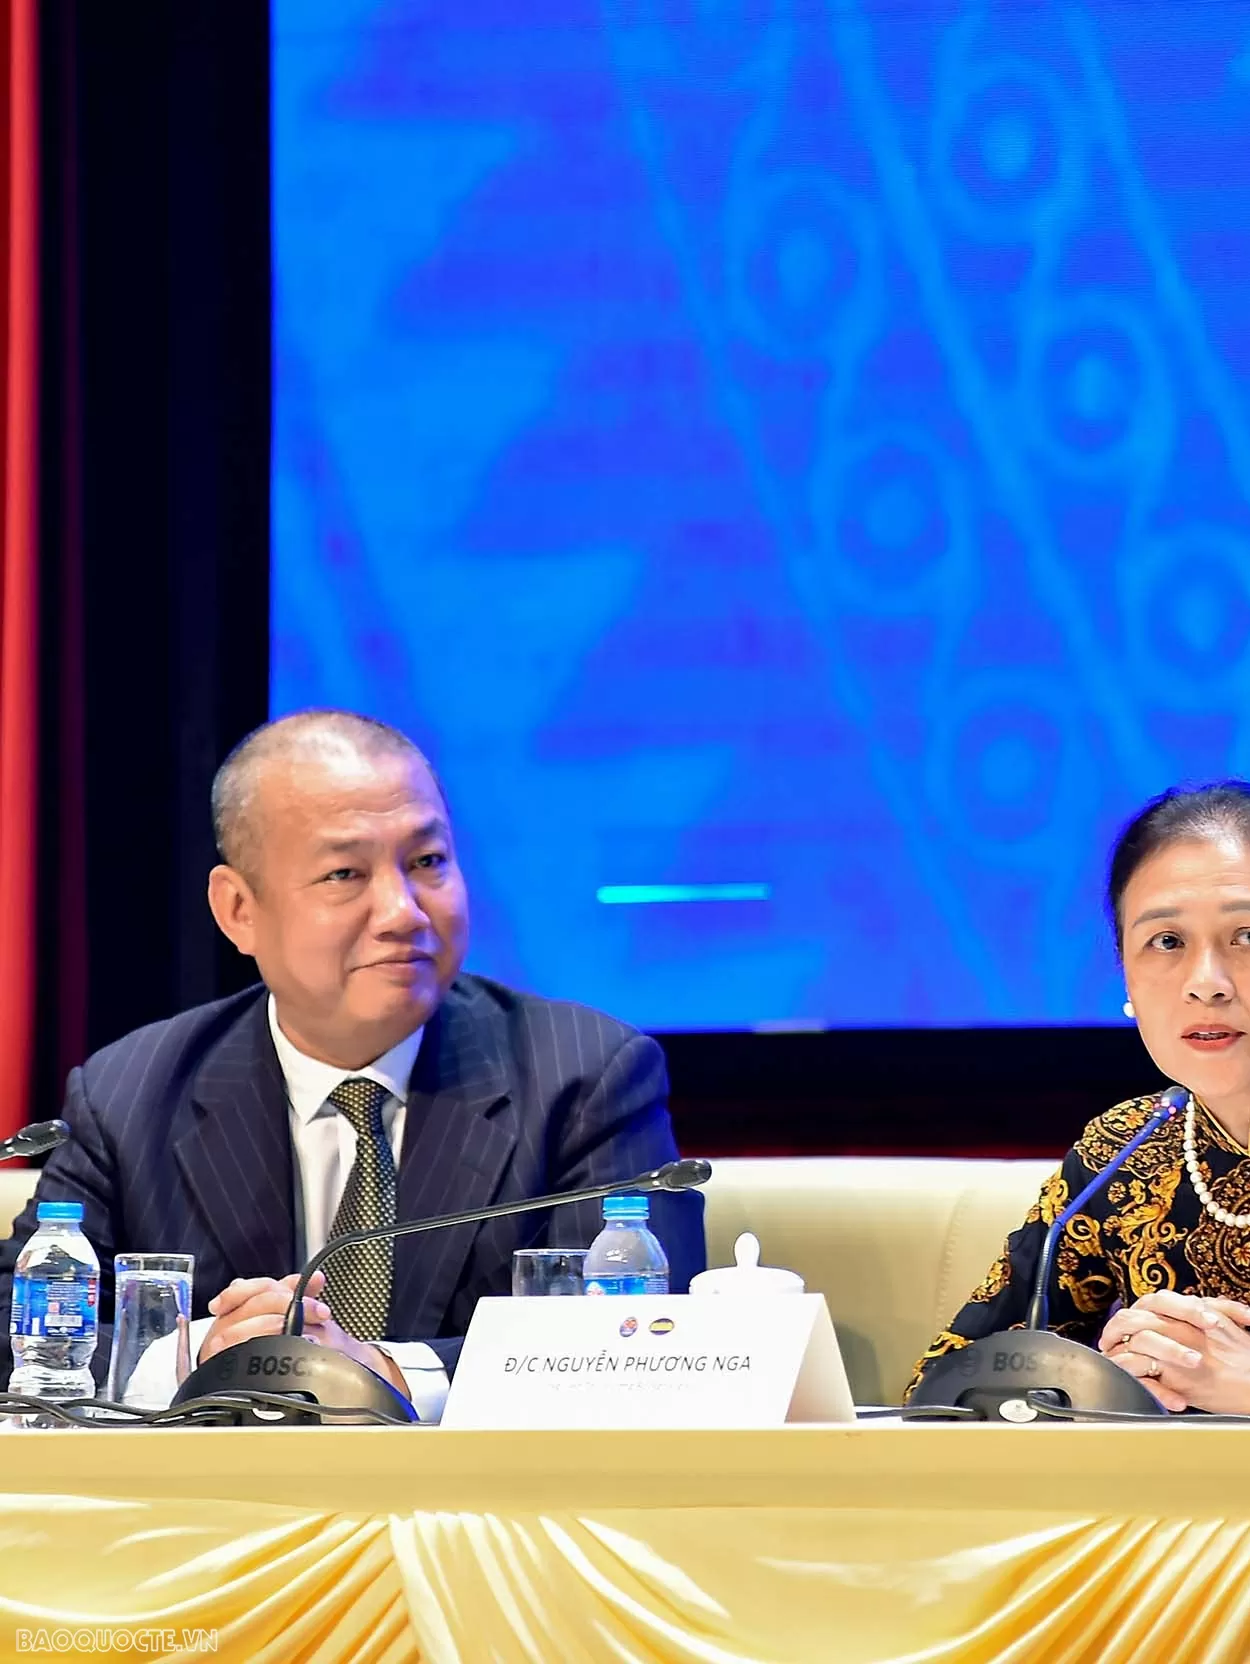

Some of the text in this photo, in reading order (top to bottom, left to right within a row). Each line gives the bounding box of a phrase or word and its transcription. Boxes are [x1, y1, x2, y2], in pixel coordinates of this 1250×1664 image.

[246, 1355, 327, 1377] BOSC
[503, 1348, 752, 1376] Đ/C NGUYỄN PHƯƠNG NGA
